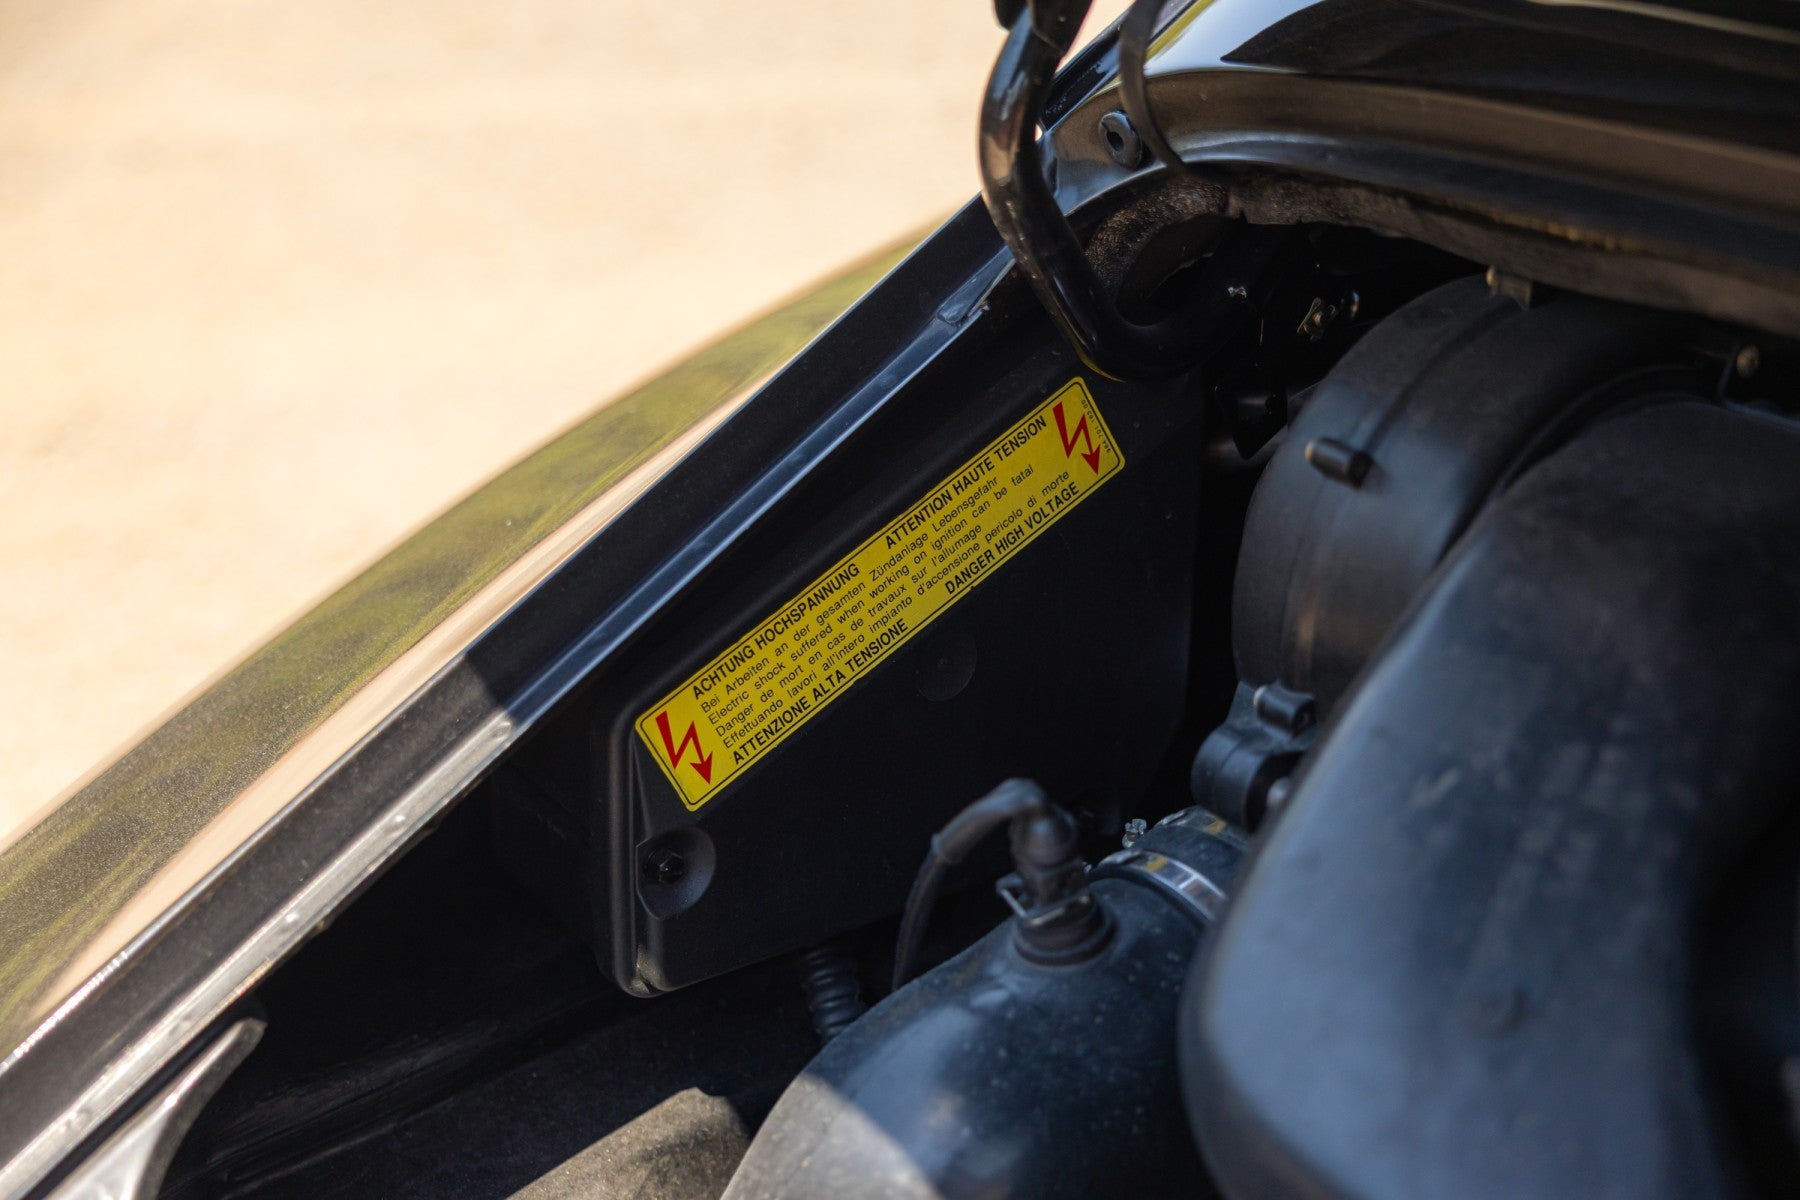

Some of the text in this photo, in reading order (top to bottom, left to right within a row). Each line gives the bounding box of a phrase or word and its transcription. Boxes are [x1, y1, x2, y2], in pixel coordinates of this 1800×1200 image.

[885, 414, 1047, 550] ATTENTION HAUTE TENSION
[944, 481, 1080, 595] DANGER HIGH VOLTAGE
[692, 562, 861, 700] ACHTUNG HOCHSPANNUNG
[700, 476, 998, 714] Bei Arbeiten an der gesamten Zündanlage Lebensgefahr
[707, 464, 1034, 725] Electric shock suffered when working on ignition can be fatal
[715, 524, 982, 737] Danger de mort en cas de travaux sur l'allumage
[722, 471, 1070, 749] Effettuando lavori all'intero impianto d'accensione pericolo di morte
[732, 617, 909, 765] ATTENZIONE ALTA TENSIONE
